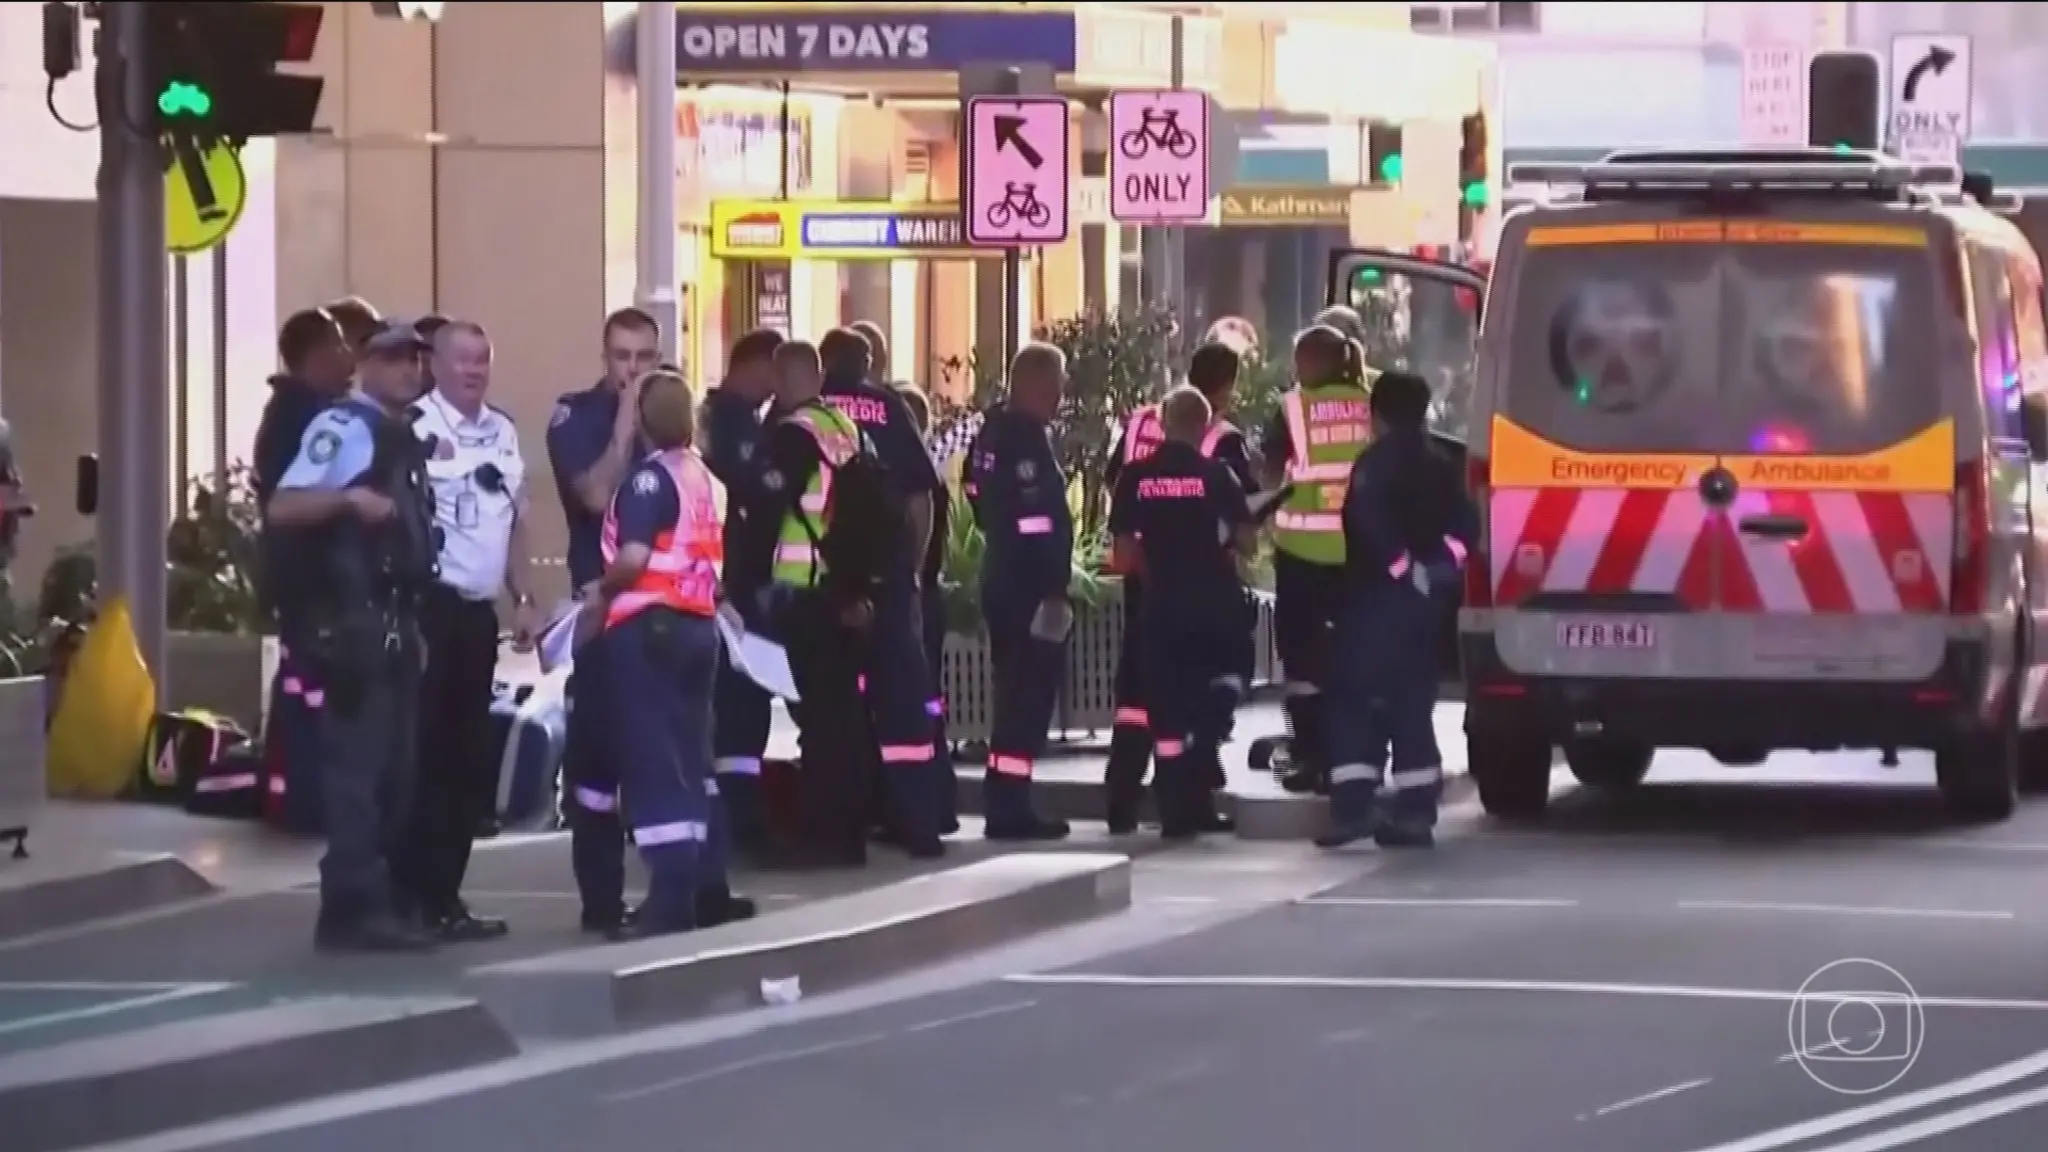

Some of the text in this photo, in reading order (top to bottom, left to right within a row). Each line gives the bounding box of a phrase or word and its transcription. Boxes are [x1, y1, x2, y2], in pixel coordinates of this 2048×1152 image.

[683, 25, 930, 58] OPEN 7 DAYS
[1895, 111, 1962, 135] ONLY
[1124, 173, 1192, 203] ONLY
[1550, 456, 1890, 485] Emergency Ambulance
